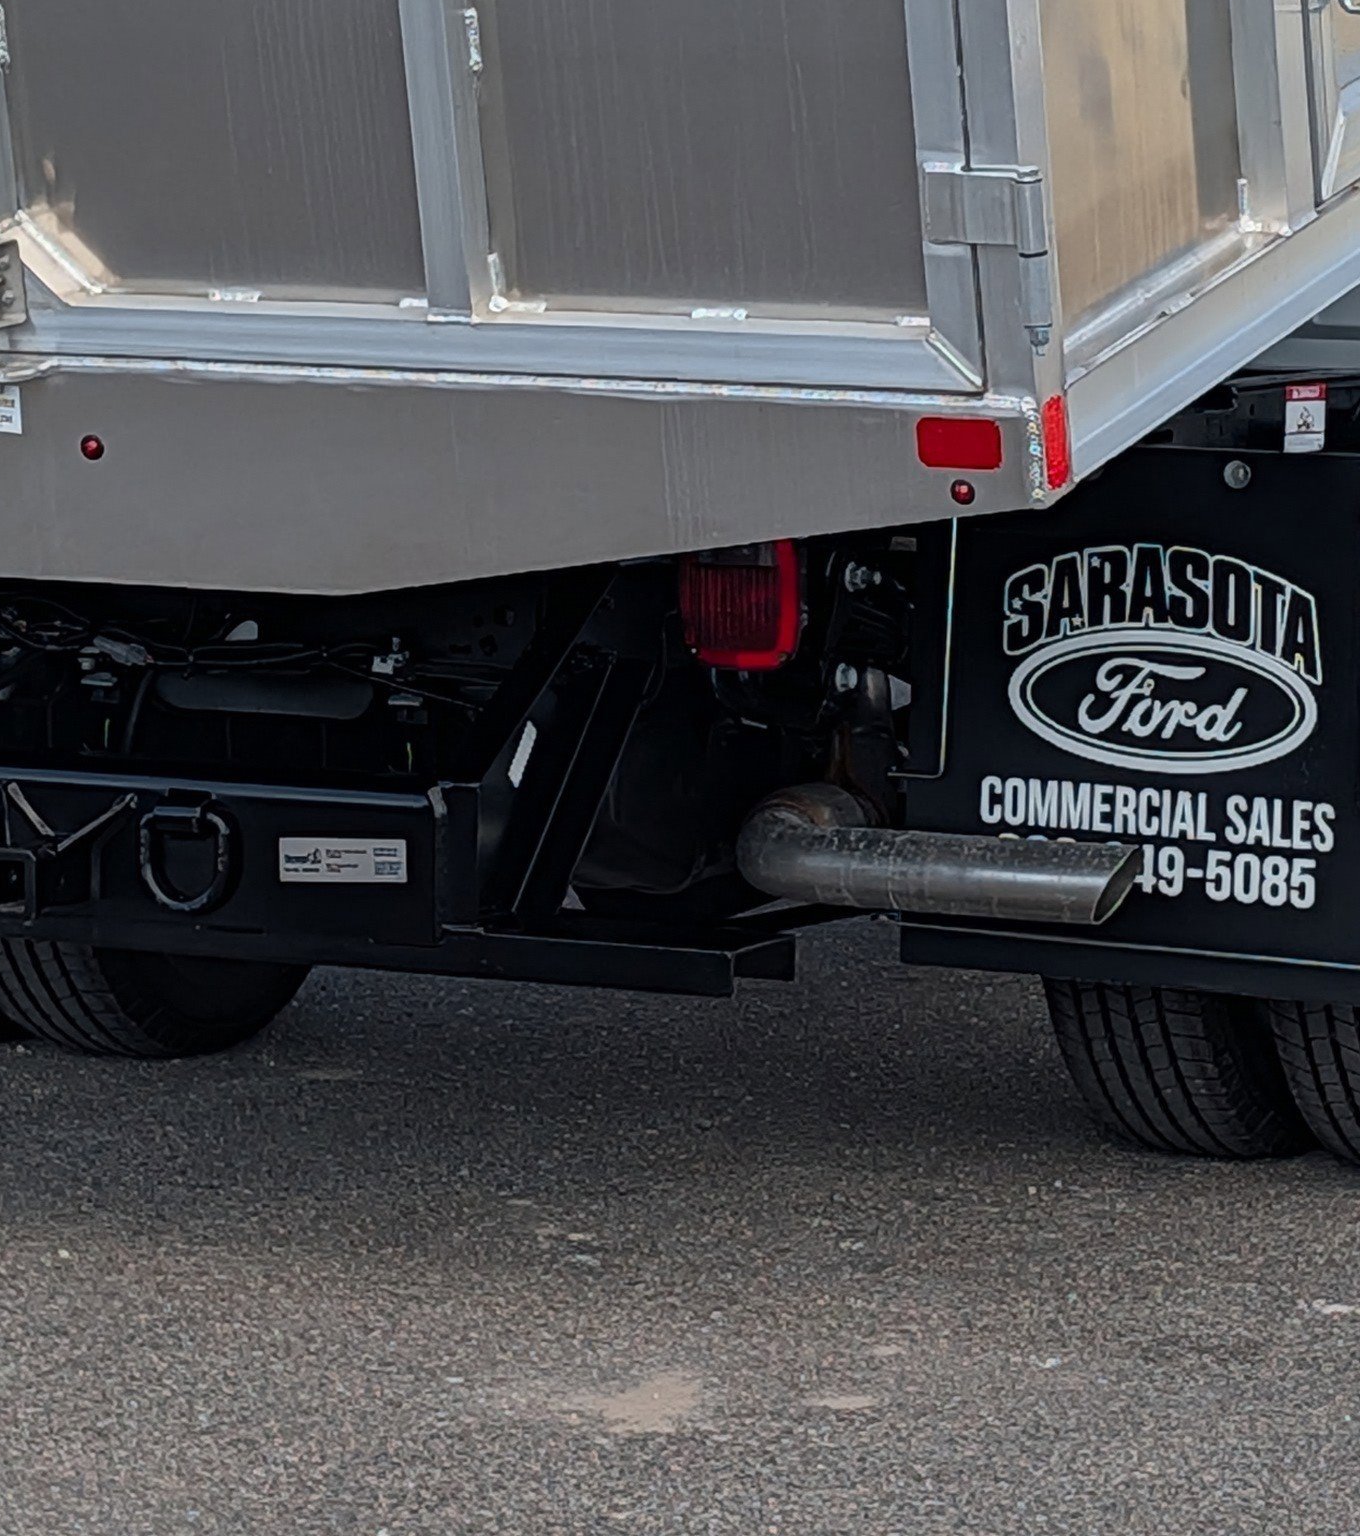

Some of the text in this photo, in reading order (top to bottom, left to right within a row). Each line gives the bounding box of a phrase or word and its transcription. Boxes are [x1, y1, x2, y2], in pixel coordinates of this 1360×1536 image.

[1003, 543, 1323, 686] SARASOTA
[1077, 657, 1249, 743] Ford
[979, 775, 1336, 853] COMMERCIAL SALES
